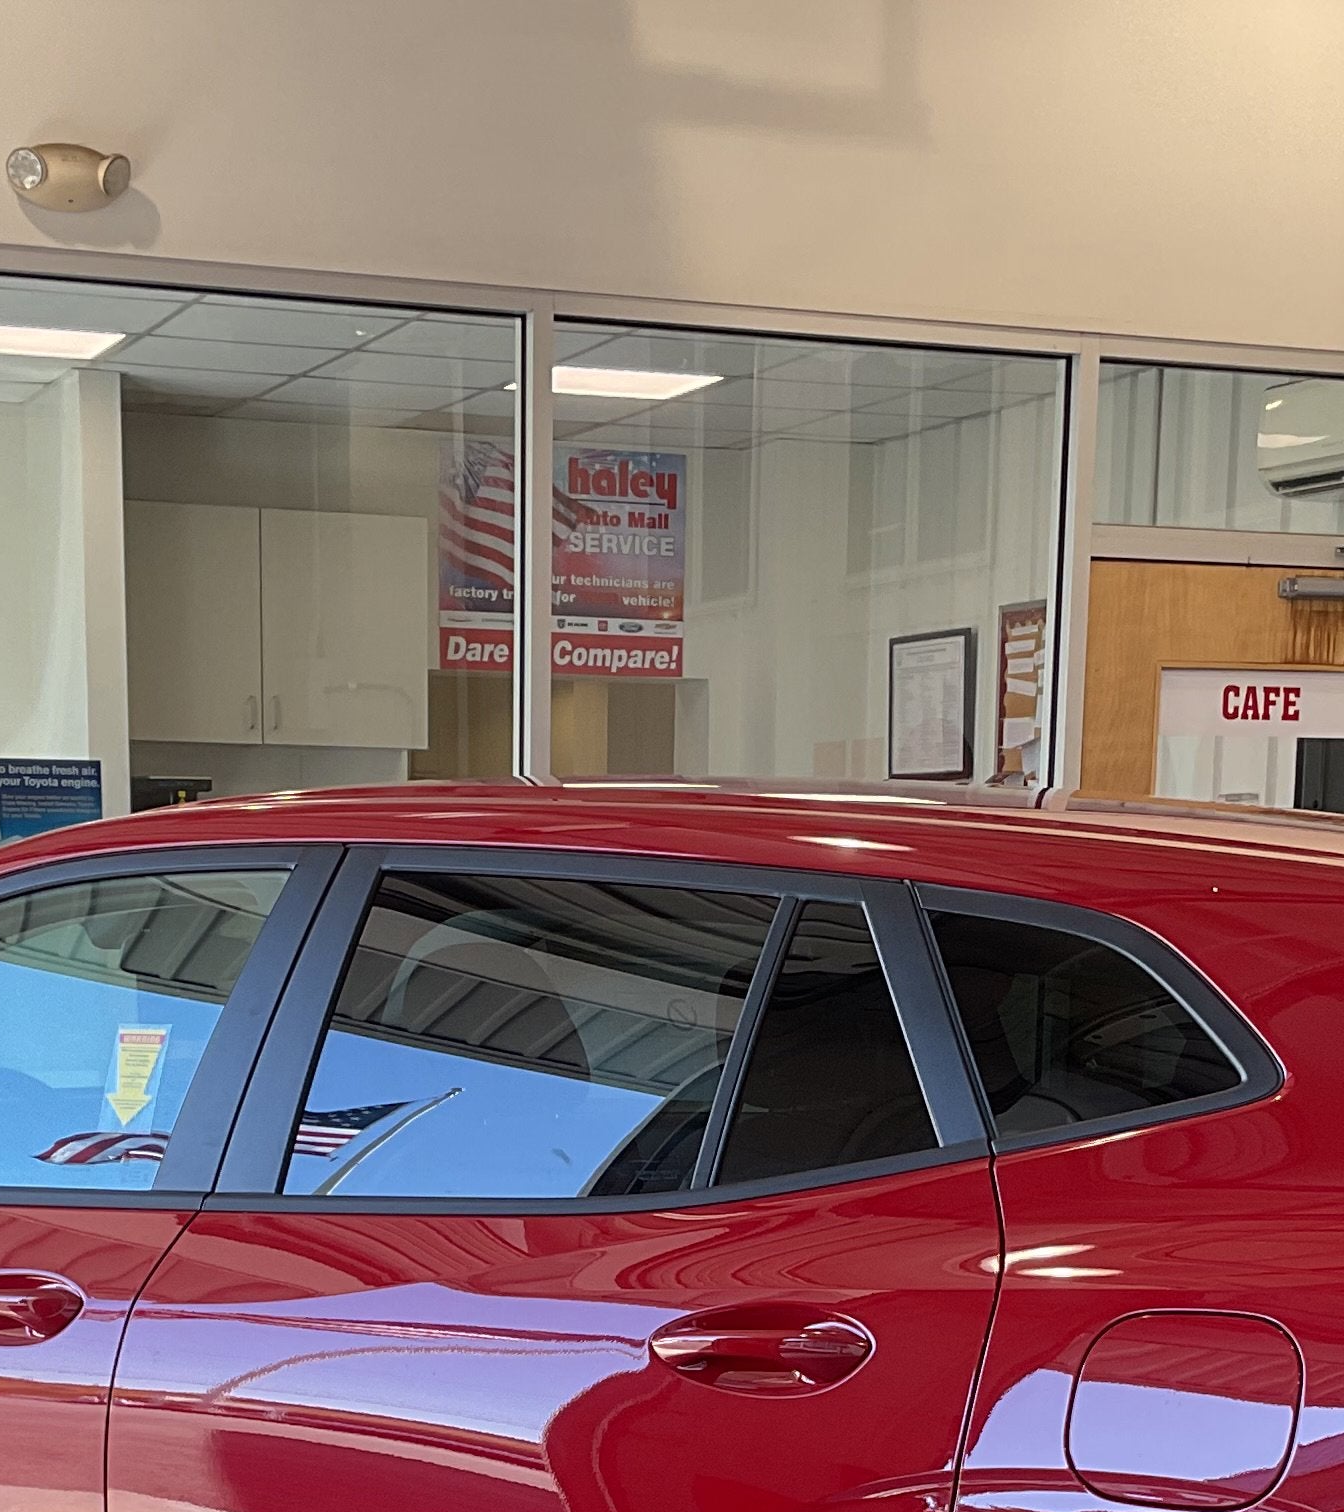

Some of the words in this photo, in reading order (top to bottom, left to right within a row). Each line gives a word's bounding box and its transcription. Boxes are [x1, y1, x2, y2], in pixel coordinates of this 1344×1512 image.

[568, 457, 677, 510] haley
[628, 511, 669, 529] Mall
[569, 531, 674, 557] SERVICE
[552, 574, 567, 585] ur
[570, 574, 649, 589] technicians
[653, 579, 675, 590] are
[449, 584, 498, 601] factory
[622, 594, 675, 608] vehicle!
[446, 635, 509, 663] Dare
[553, 639, 679, 673] Compare!
[1221, 684, 1301, 721] CAFE
[8, 764, 50, 776] breathe
[52, 765, 79, 776] fresh
[23, 776, 59, 789] Toyota
